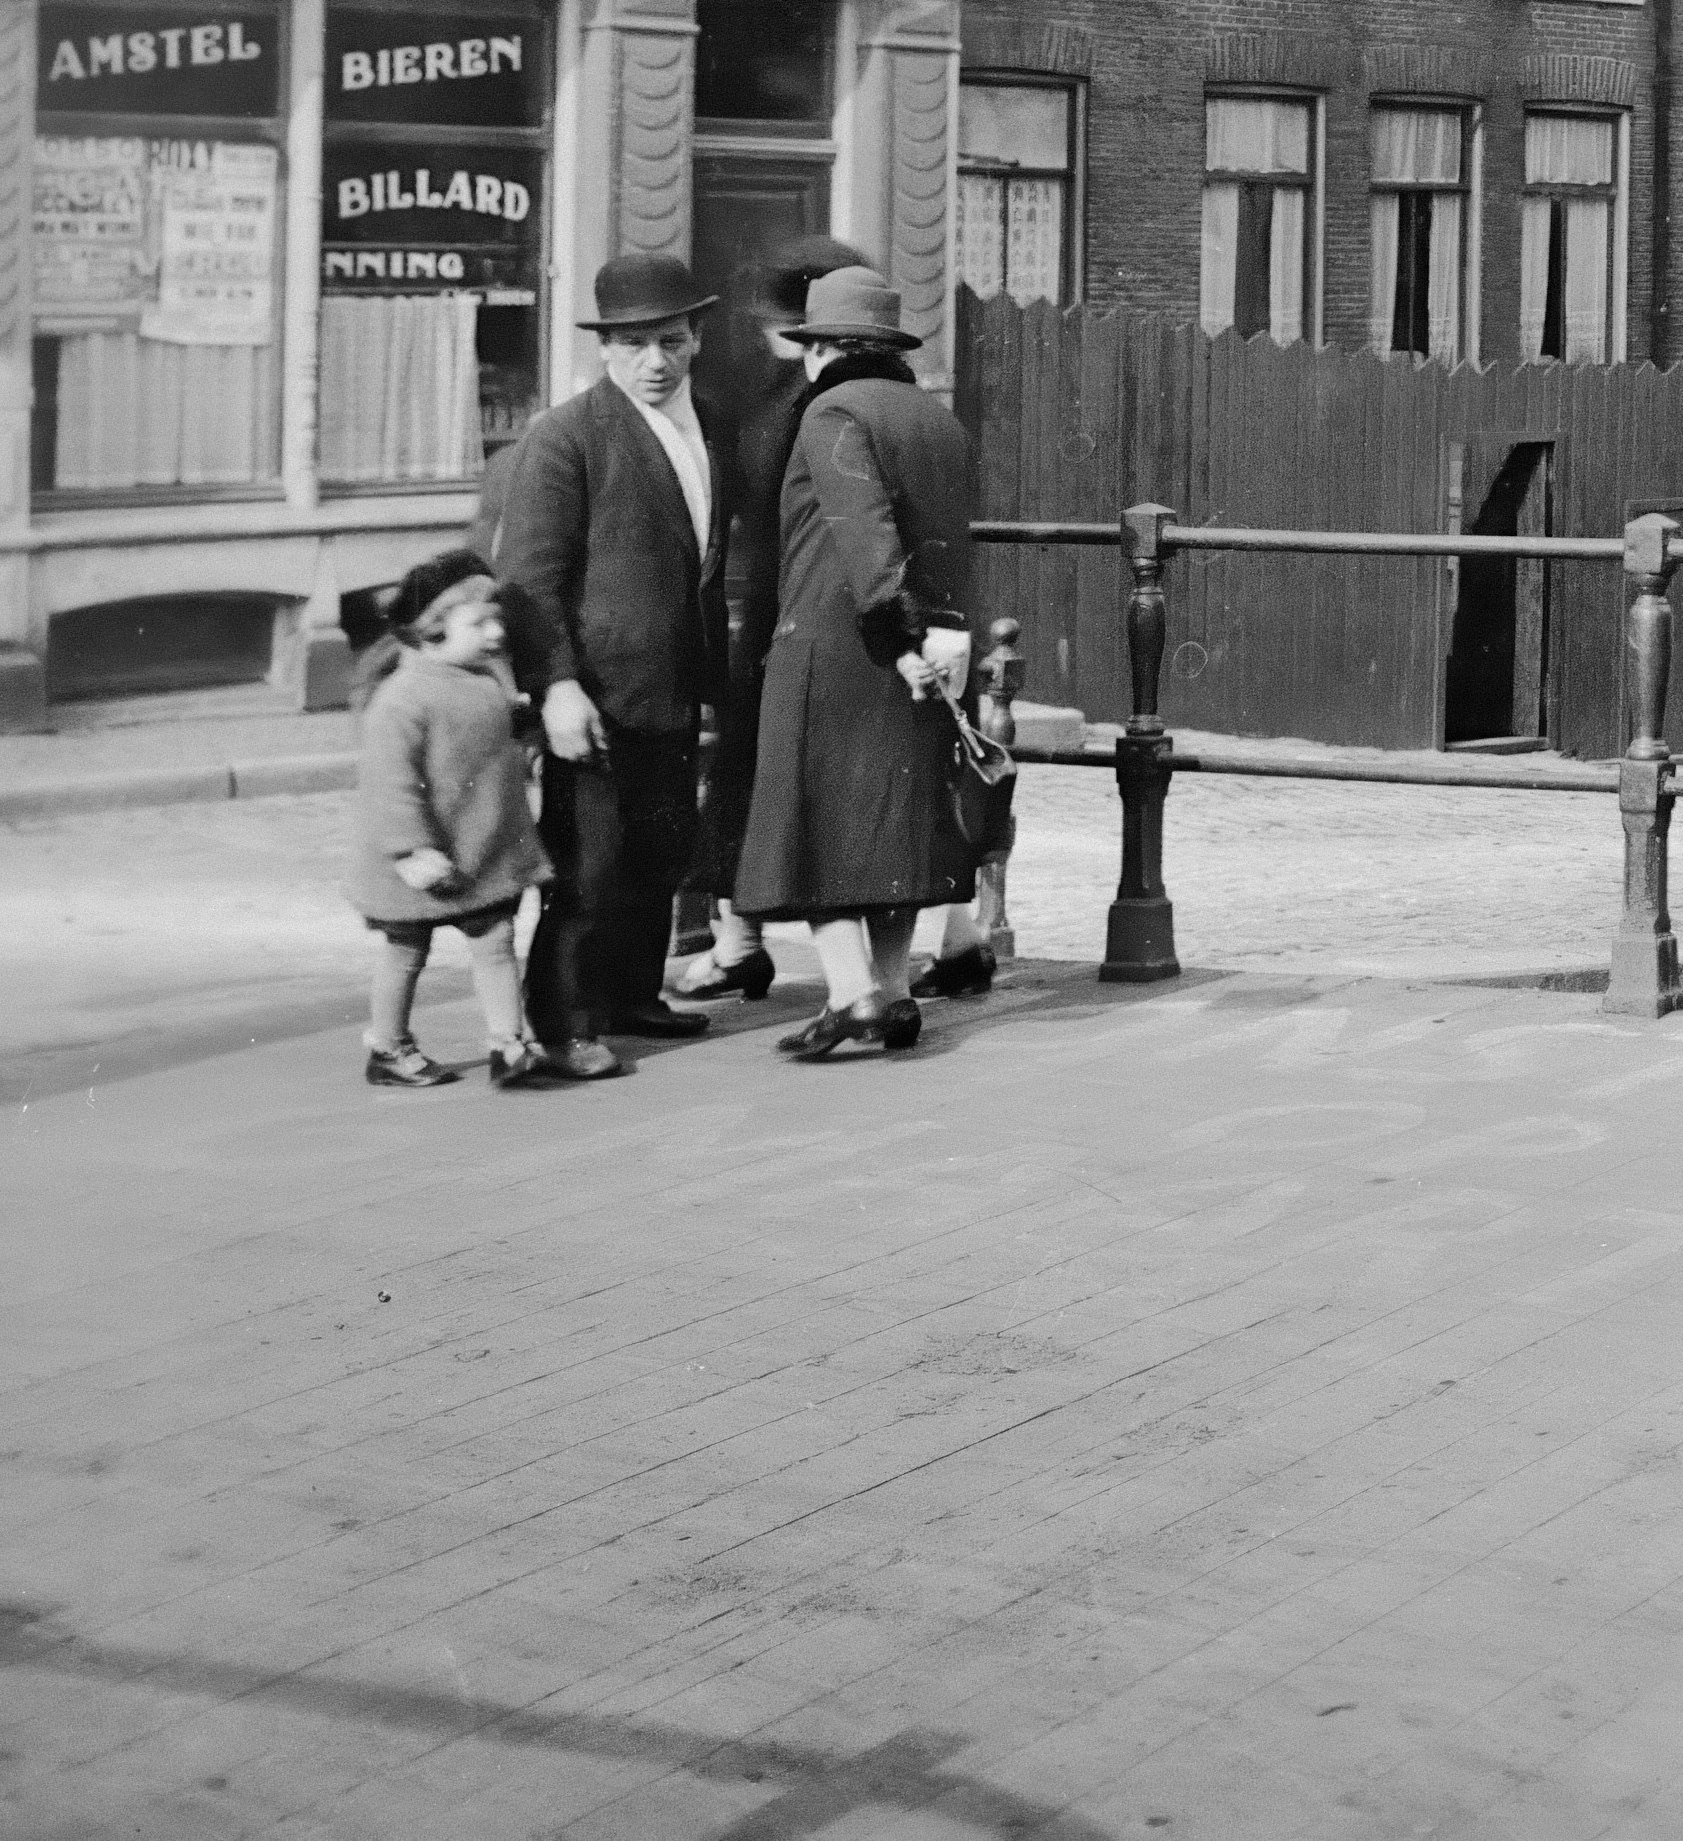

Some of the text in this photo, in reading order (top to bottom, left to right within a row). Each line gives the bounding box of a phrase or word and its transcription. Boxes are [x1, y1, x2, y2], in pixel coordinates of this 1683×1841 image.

[49, 21, 262, 82] AMSTEL
[340, 35, 523, 91] BIEREN
[337, 168, 530, 222] BILLARD
